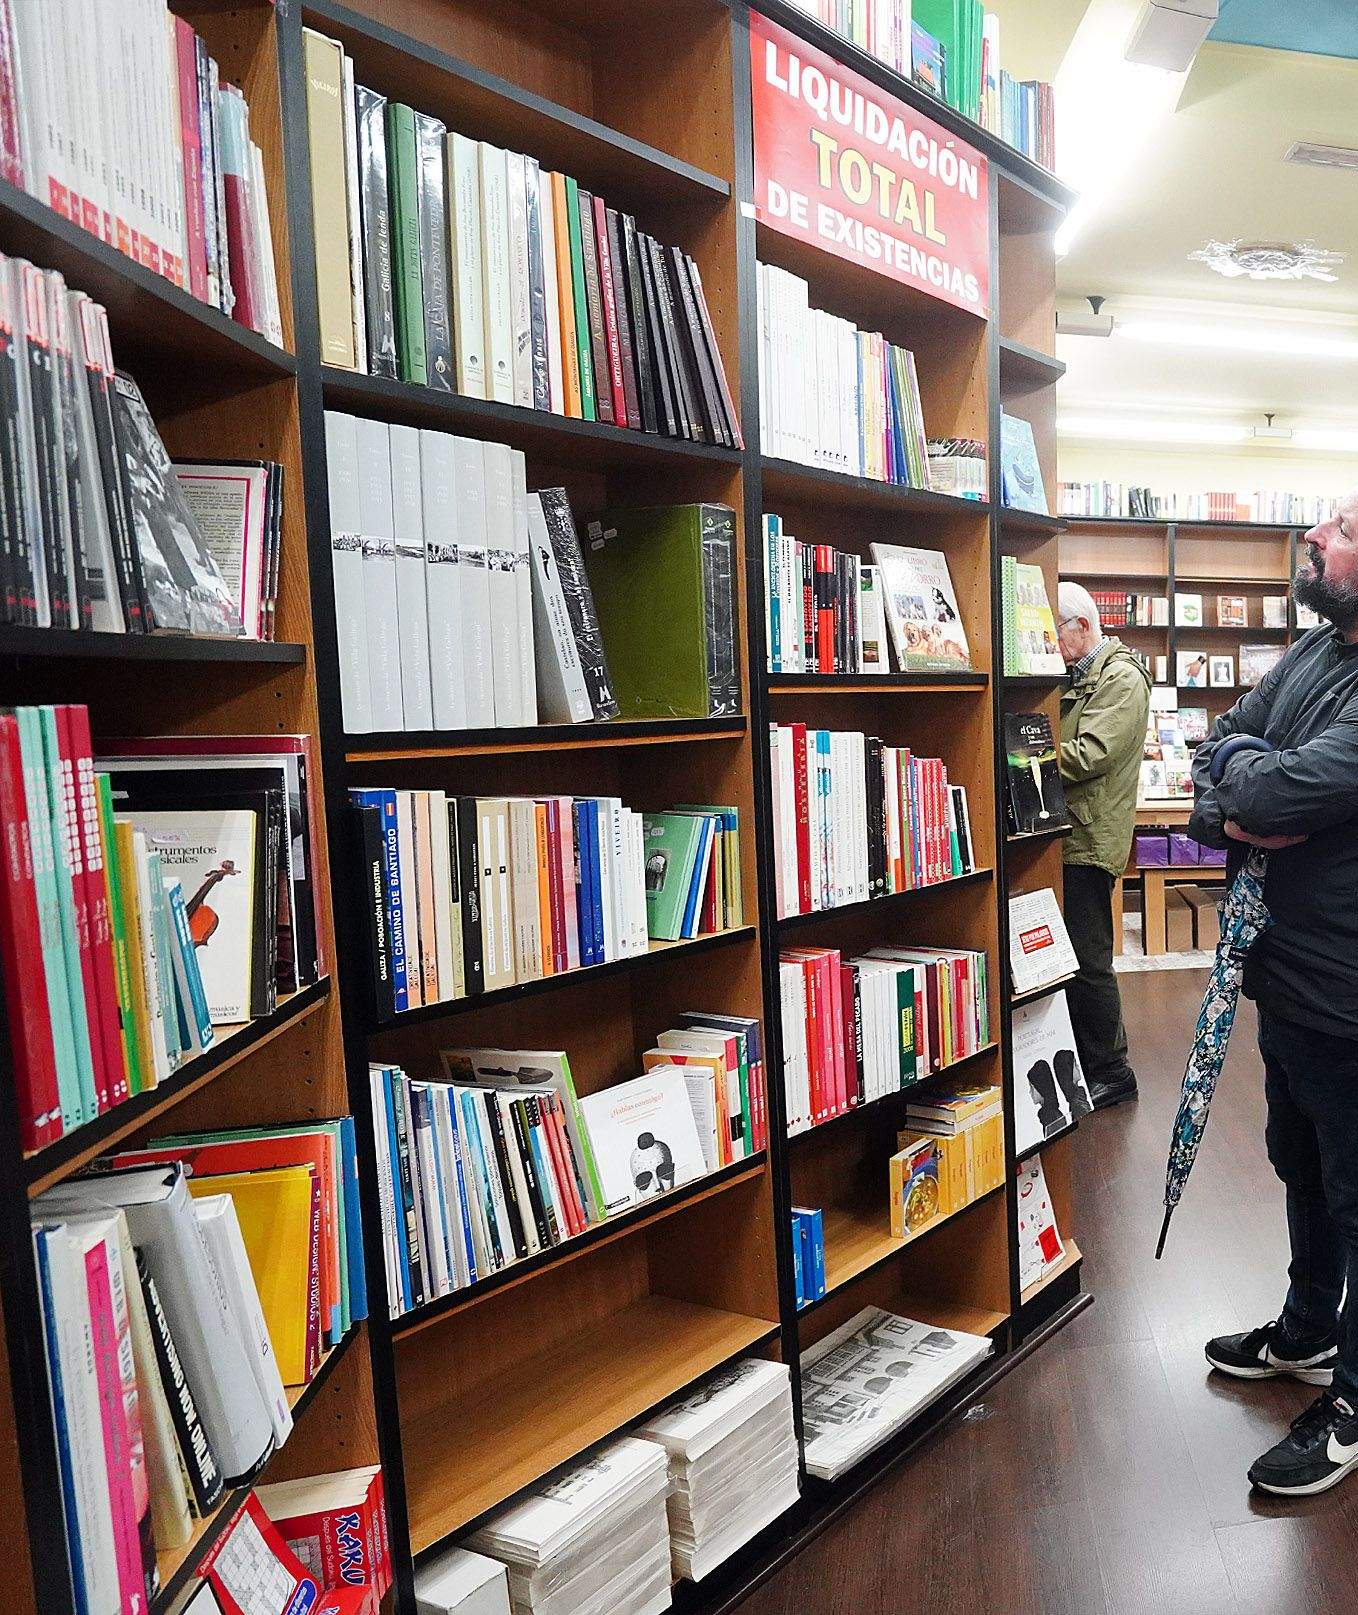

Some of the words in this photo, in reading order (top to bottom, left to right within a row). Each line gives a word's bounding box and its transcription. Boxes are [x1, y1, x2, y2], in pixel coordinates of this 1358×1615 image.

[765, 40, 978, 199] LIQUIDACIÓN
[810, 128, 946, 246] TOTAL
[377, 209, 388, 238] lenda
[767, 180, 809, 229] DE
[817, 204, 980, 304] EXISTENCIAS
[380, 241, 388, 252] de
[379, 256, 391, 292] Galicia
[593, 665, 603, 677] 17
[160, 855, 199, 865] sicales
[387, 828, 398, 886] SANTIAGO
[390, 890, 400, 905] DE
[390, 909, 404, 955] CAMINO
[395, 959, 405, 972] EL
[311, 1233, 320, 1273] DESIGN:
[148, 1277, 185, 1389] ADVERTISING
[178, 1385, 199, 1431] NOW.
[190, 1422, 218, 1489] ONLINE
[334, 1511, 366, 1586] KAKU
